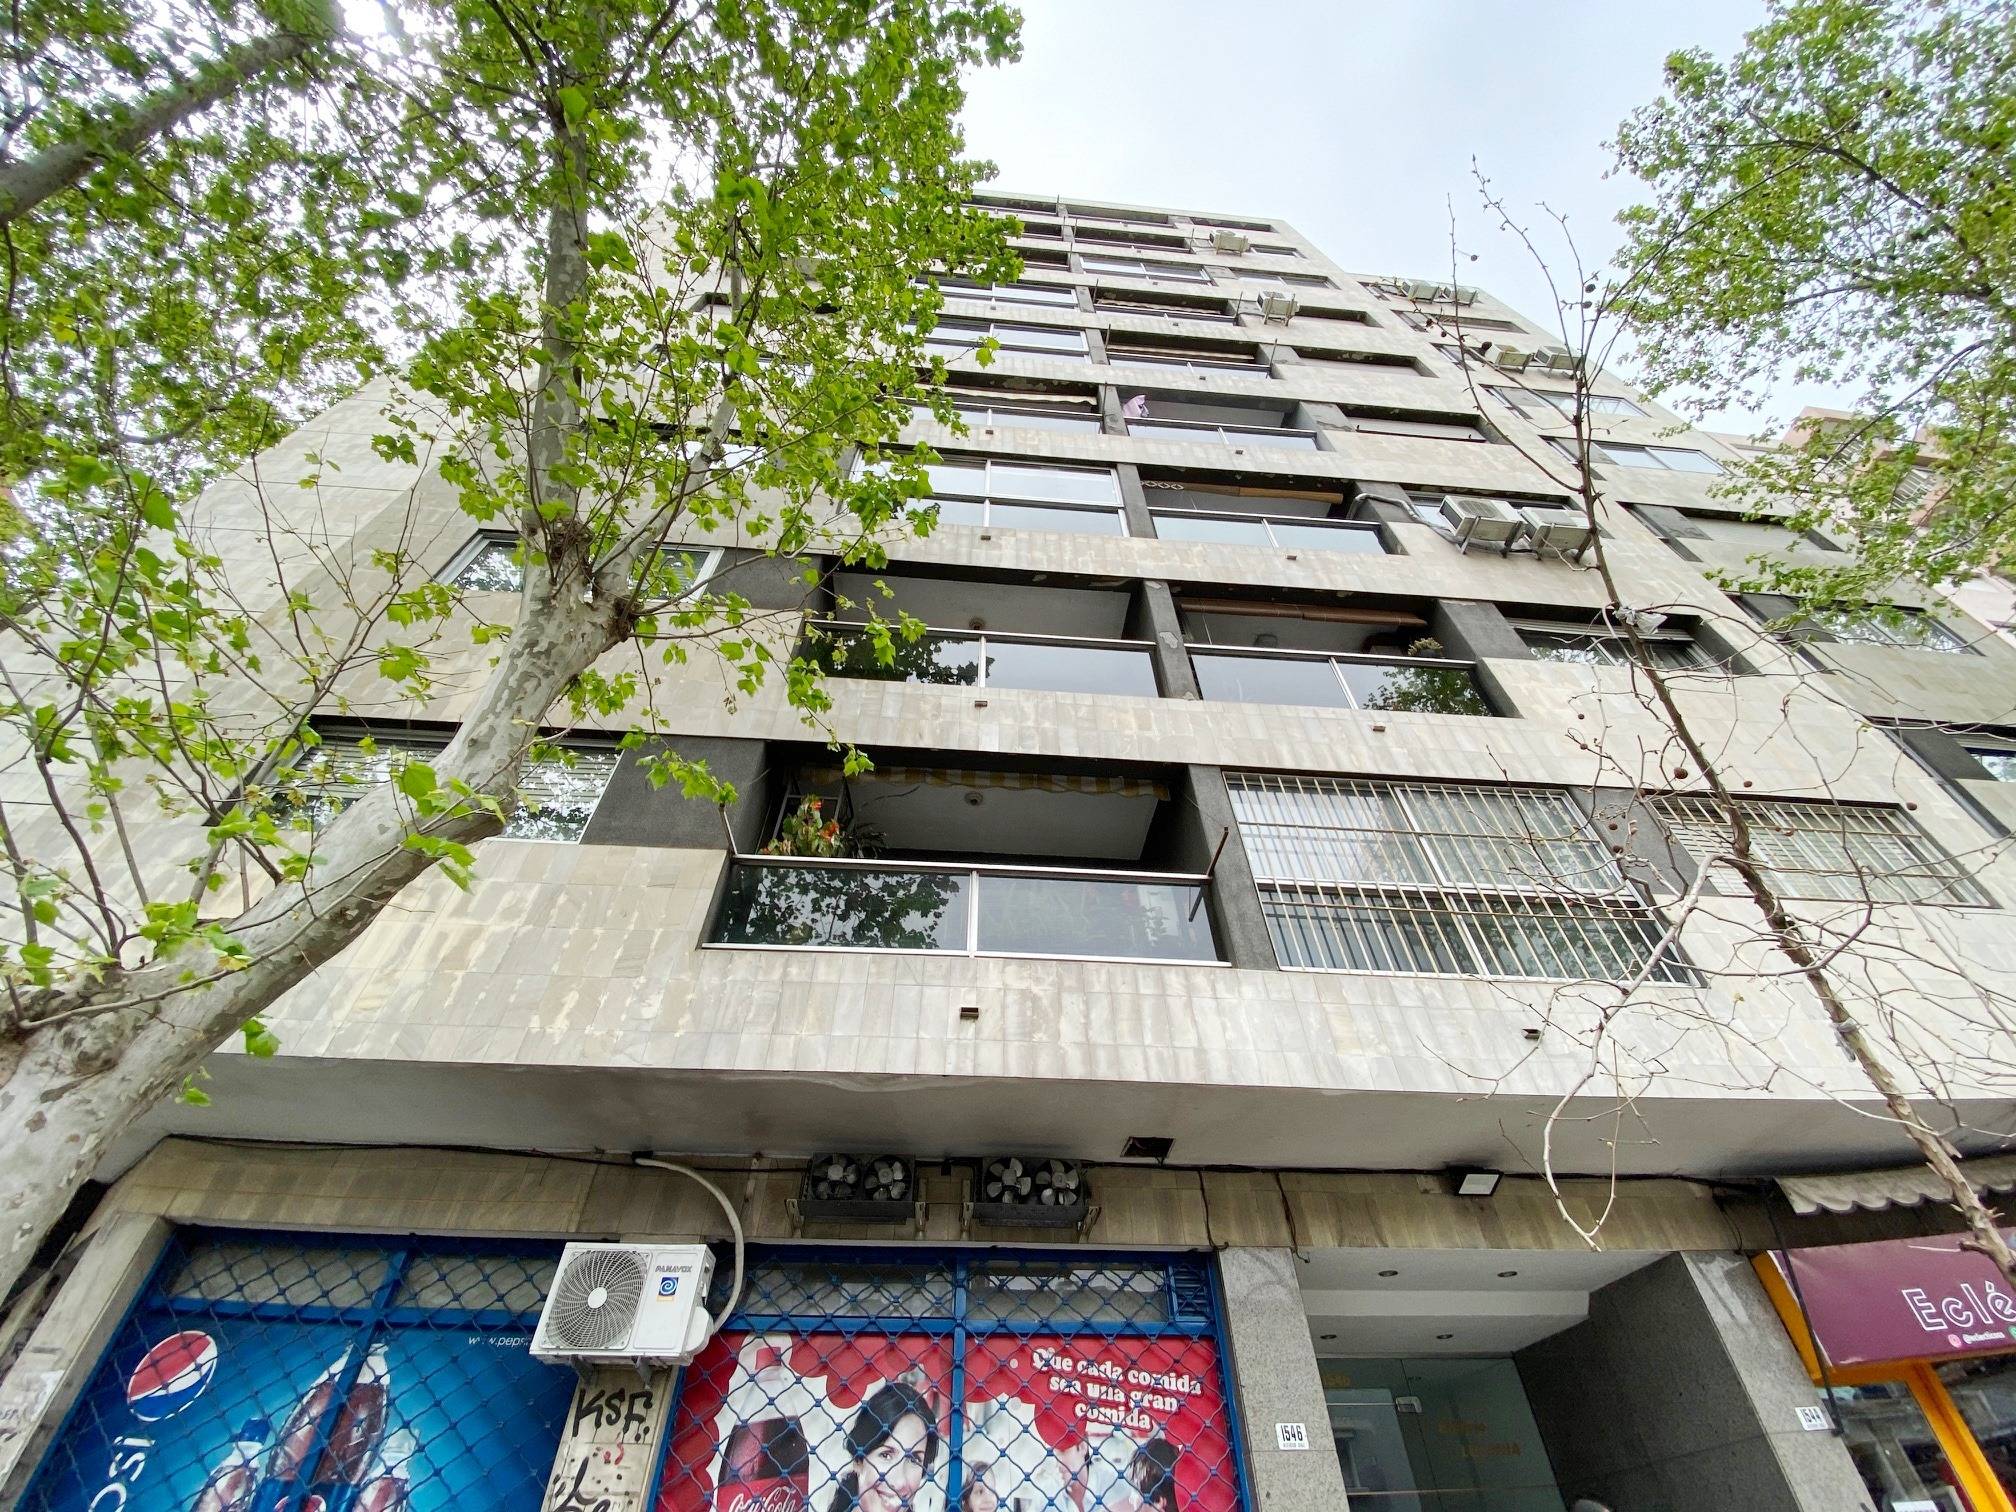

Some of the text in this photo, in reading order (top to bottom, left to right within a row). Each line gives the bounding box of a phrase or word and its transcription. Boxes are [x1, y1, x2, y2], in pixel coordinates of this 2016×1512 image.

[655, 1265, 692, 1273] PANAVOX
[1032, 1347, 1202, 1395] Que cada comida
[1049, 1376, 1178, 1412] sea una gran
[1074, 1402, 1150, 1430] comida
[1800, 1408, 1823, 1423] 1544
[1280, 1425, 1303, 1441] 1546
